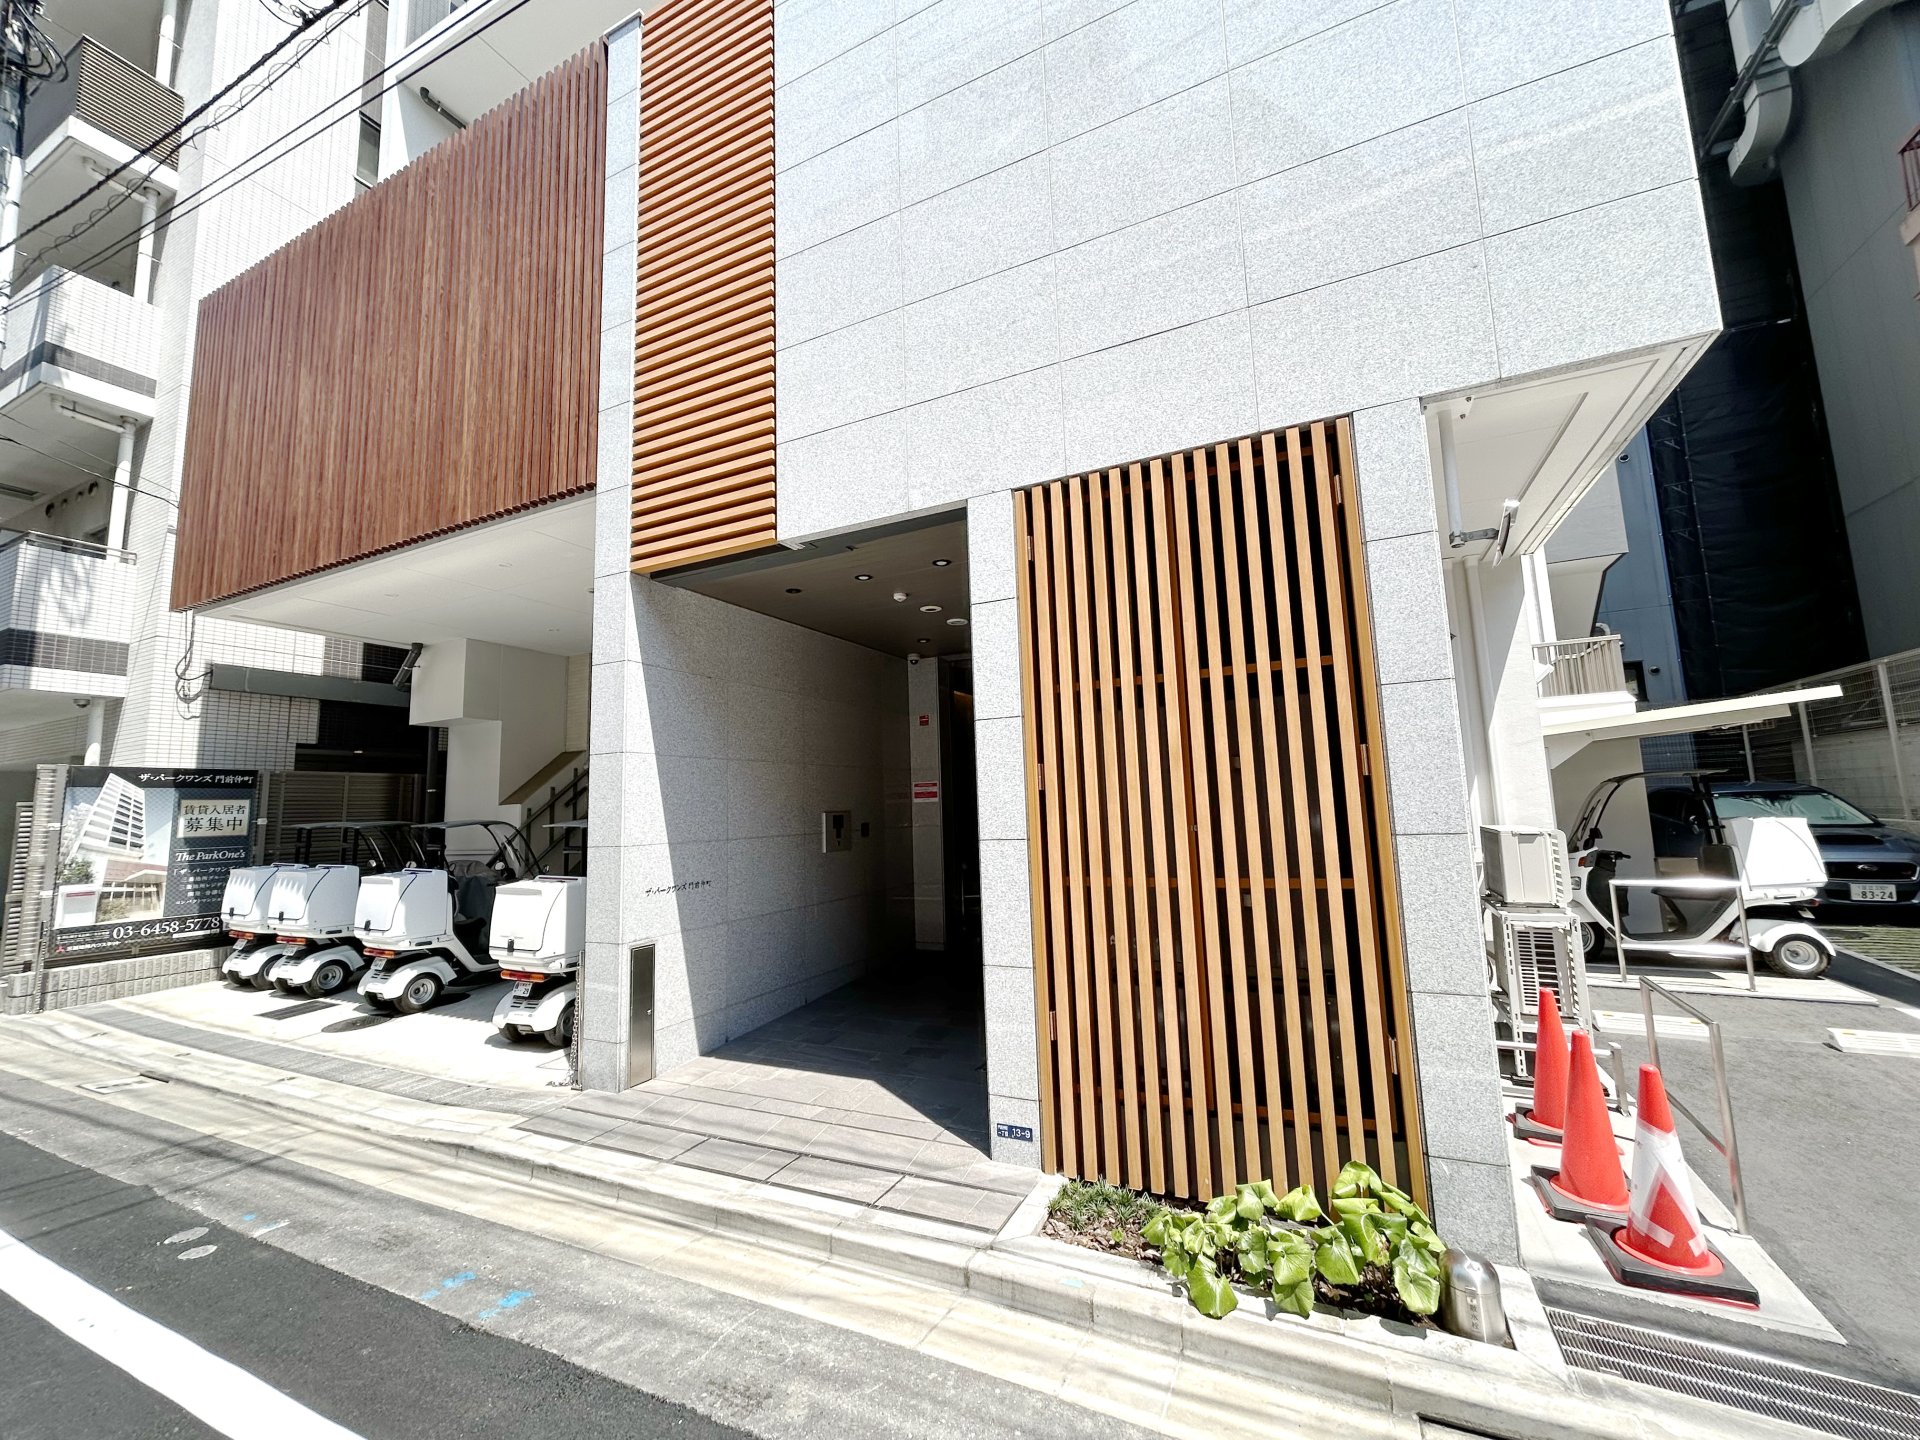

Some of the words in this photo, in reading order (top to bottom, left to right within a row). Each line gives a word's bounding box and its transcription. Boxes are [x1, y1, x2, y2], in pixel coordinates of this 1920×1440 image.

[184, 804, 247, 815] 賃貸入居者
[185, 817, 243, 832] 募集中
[176, 851, 195, 862] The
[196, 849, 246, 861] ParkOne's
[1861, 890, 1894, 900] 83-24
[112, 916, 220, 939] 03-6458-5778
[1012, 1128, 1031, 1139] 13-9
